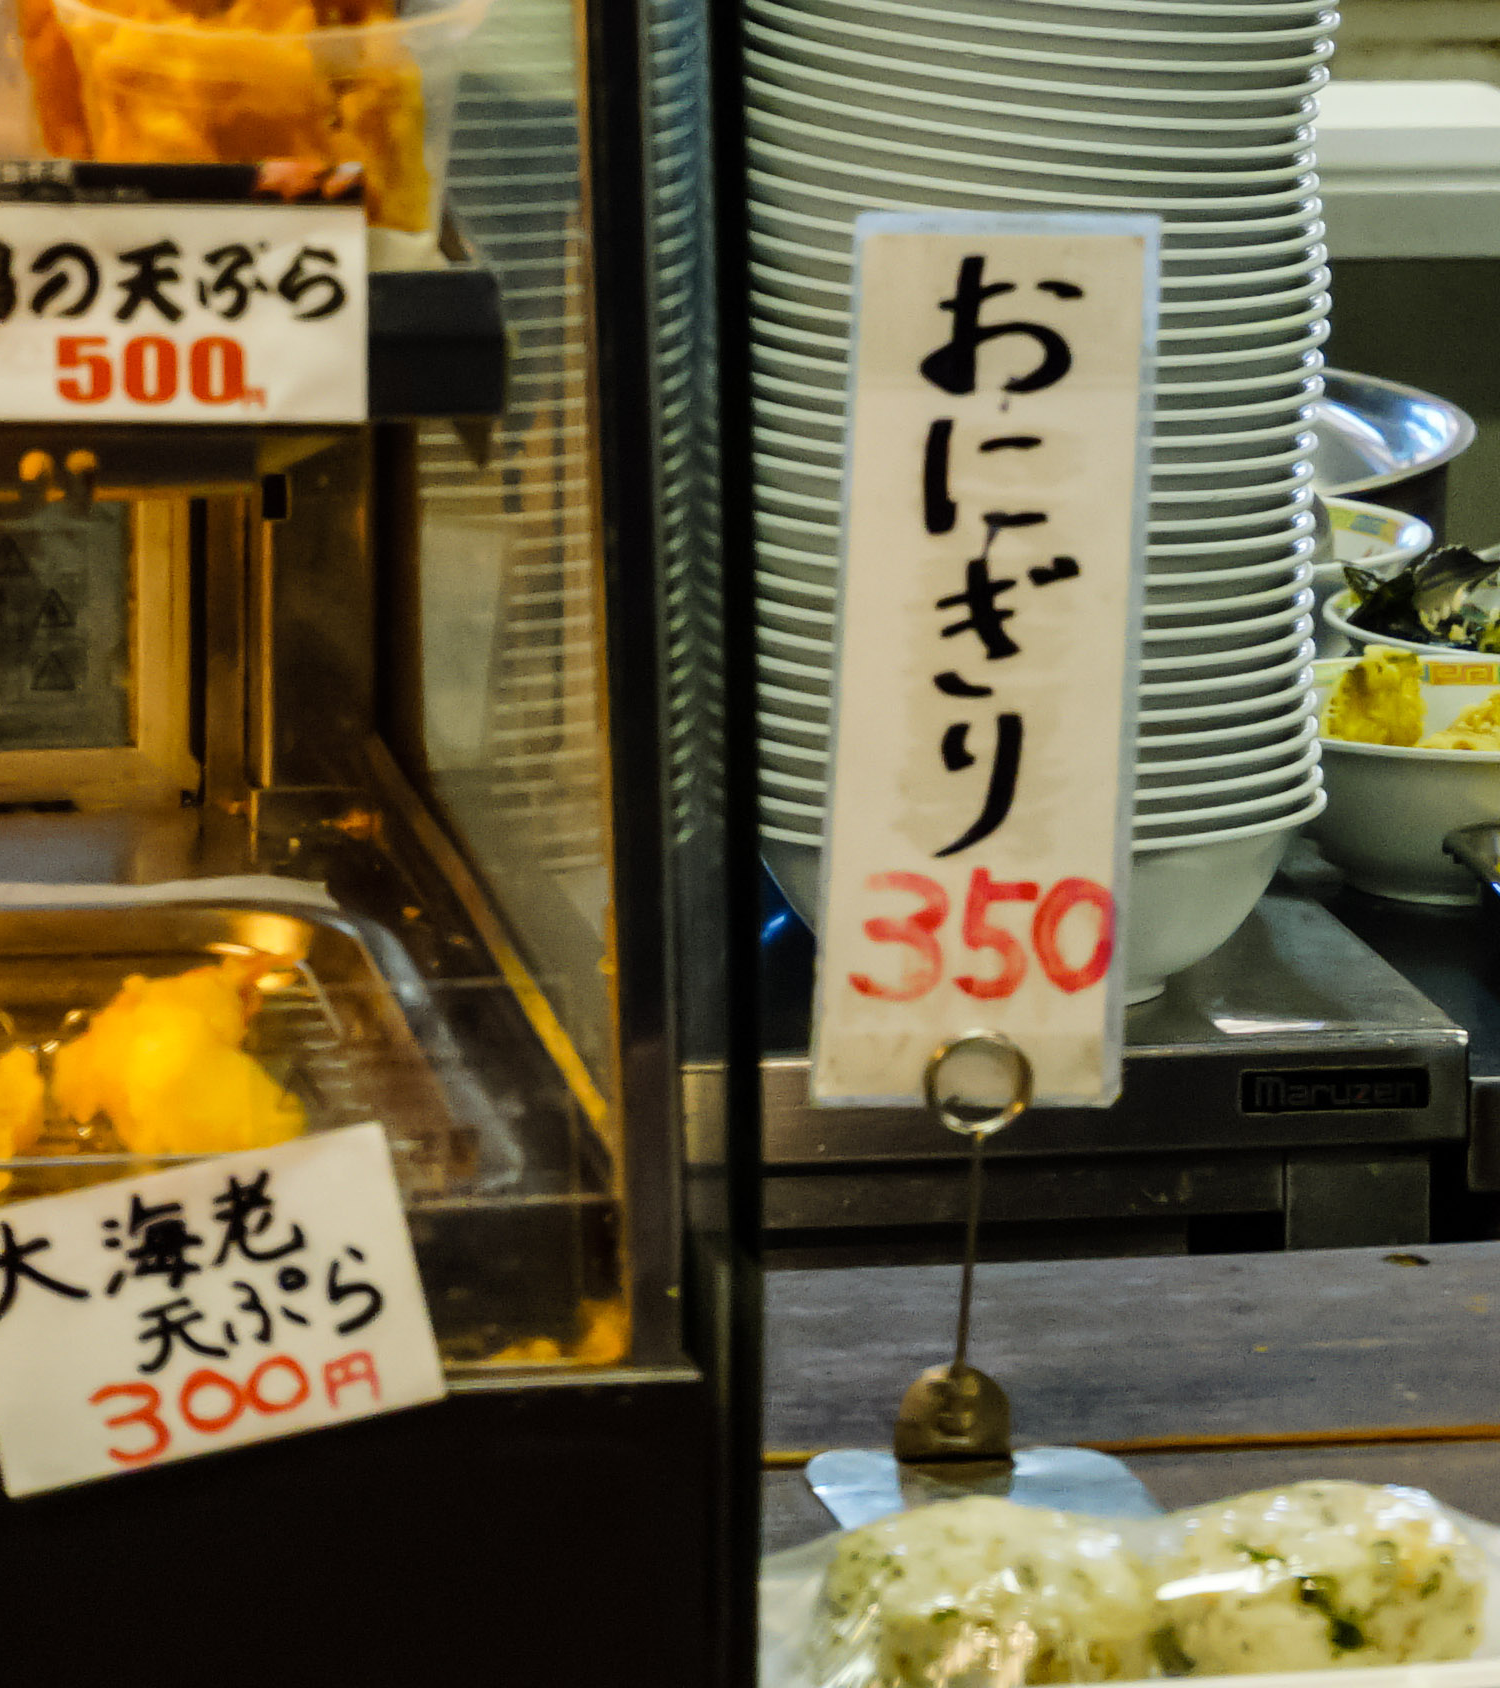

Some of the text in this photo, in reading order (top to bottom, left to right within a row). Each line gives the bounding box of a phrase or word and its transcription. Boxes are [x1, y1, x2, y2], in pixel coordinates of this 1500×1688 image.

[919, 255, 1084, 858] おにぎり
[847, 866, 1116, 1003] 350
[1254, 1075, 1417, 1108] Maruzen
[136, 1246, 385, 1374] 天ぷら
[88, 1349, 381, 1468] 300円
